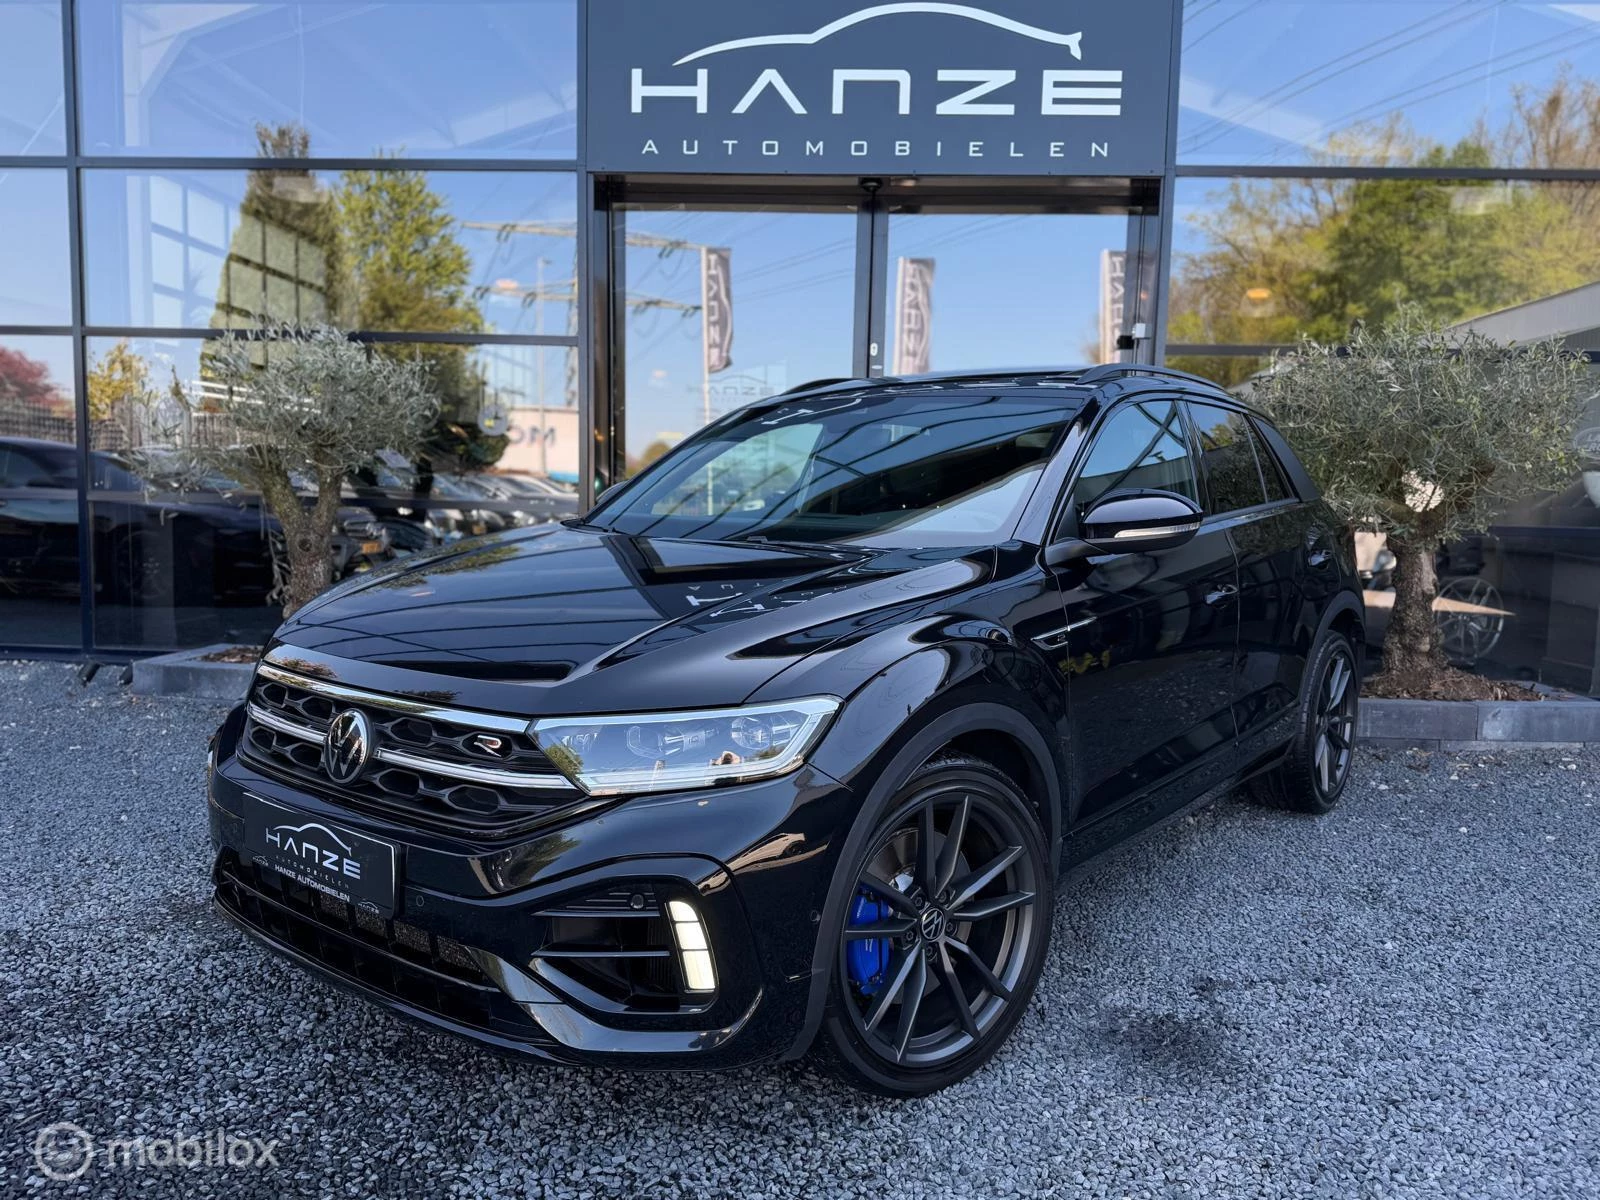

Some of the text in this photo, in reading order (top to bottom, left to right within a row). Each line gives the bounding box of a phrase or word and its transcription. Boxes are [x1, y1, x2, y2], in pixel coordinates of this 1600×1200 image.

[631, 67, 1124, 116] HANZE
[641, 139, 1109, 158] AUTOMOBIELEN
[265, 828, 361, 879] HANZE
[274, 864, 351, 903] HANZE AUTOMOBIELEN
